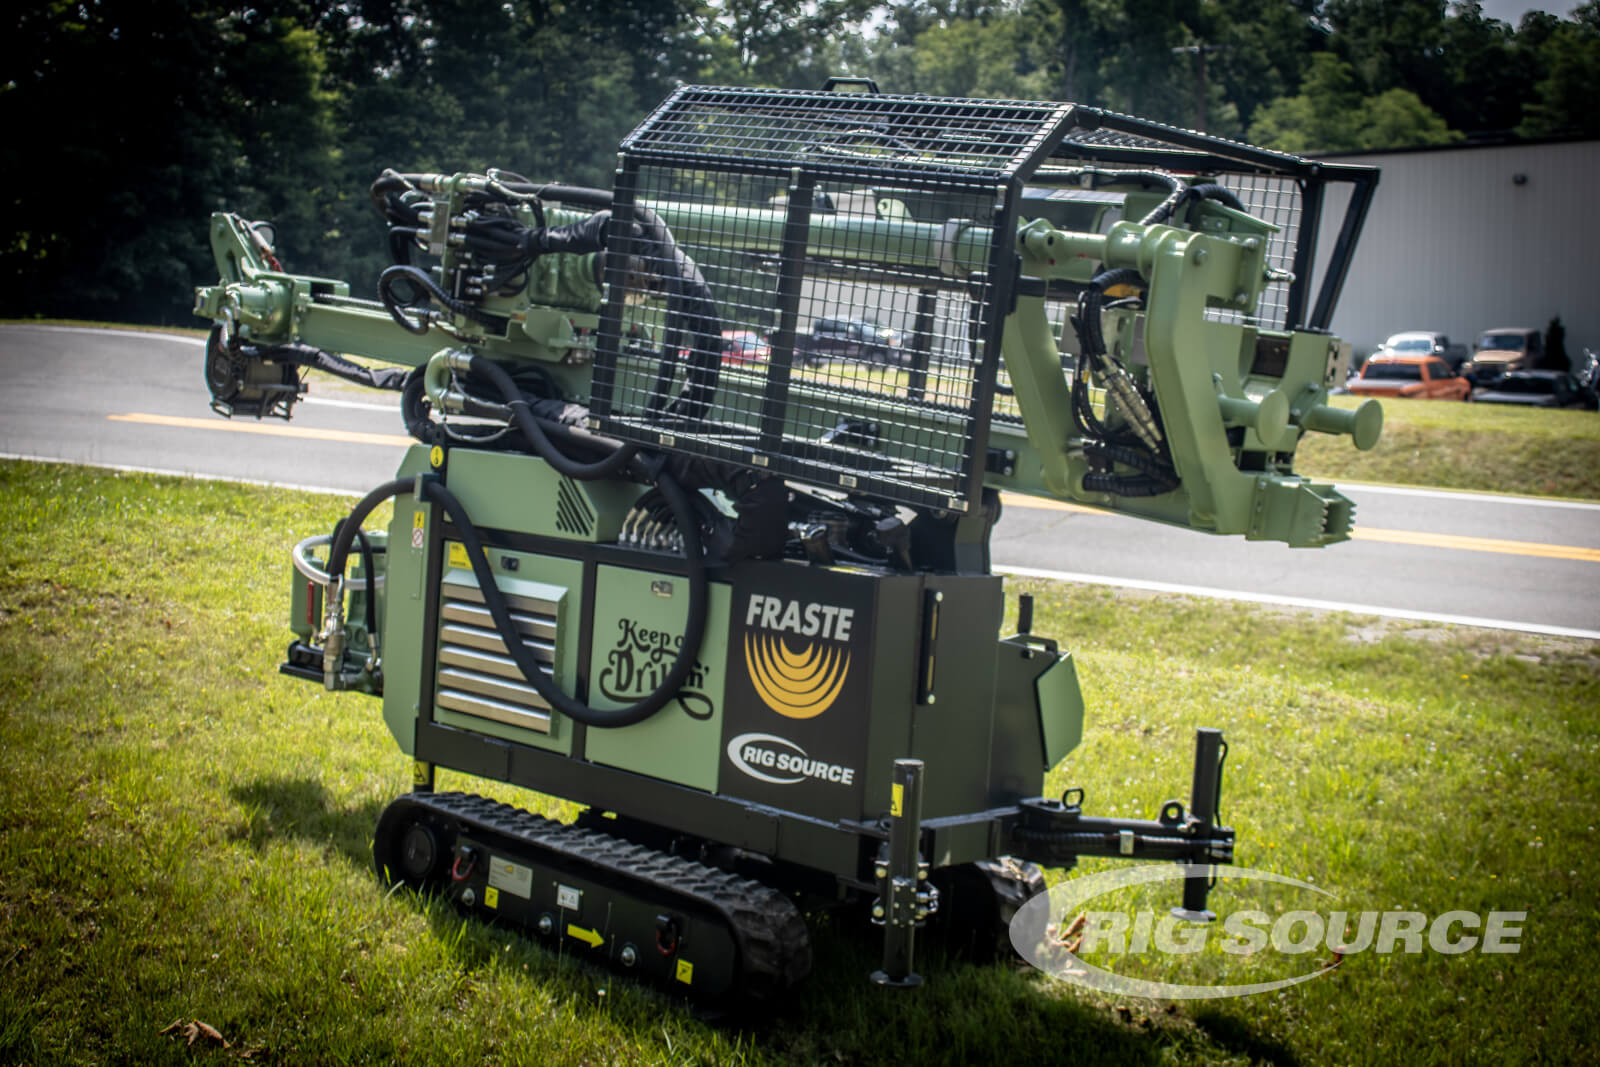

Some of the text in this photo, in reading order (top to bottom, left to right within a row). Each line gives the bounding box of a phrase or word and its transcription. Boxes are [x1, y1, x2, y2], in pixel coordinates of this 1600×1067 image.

[745, 593, 855, 642] FRASTE
[617, 618, 679, 664] Keep
[743, 745, 855, 785] RIG SOURCE
